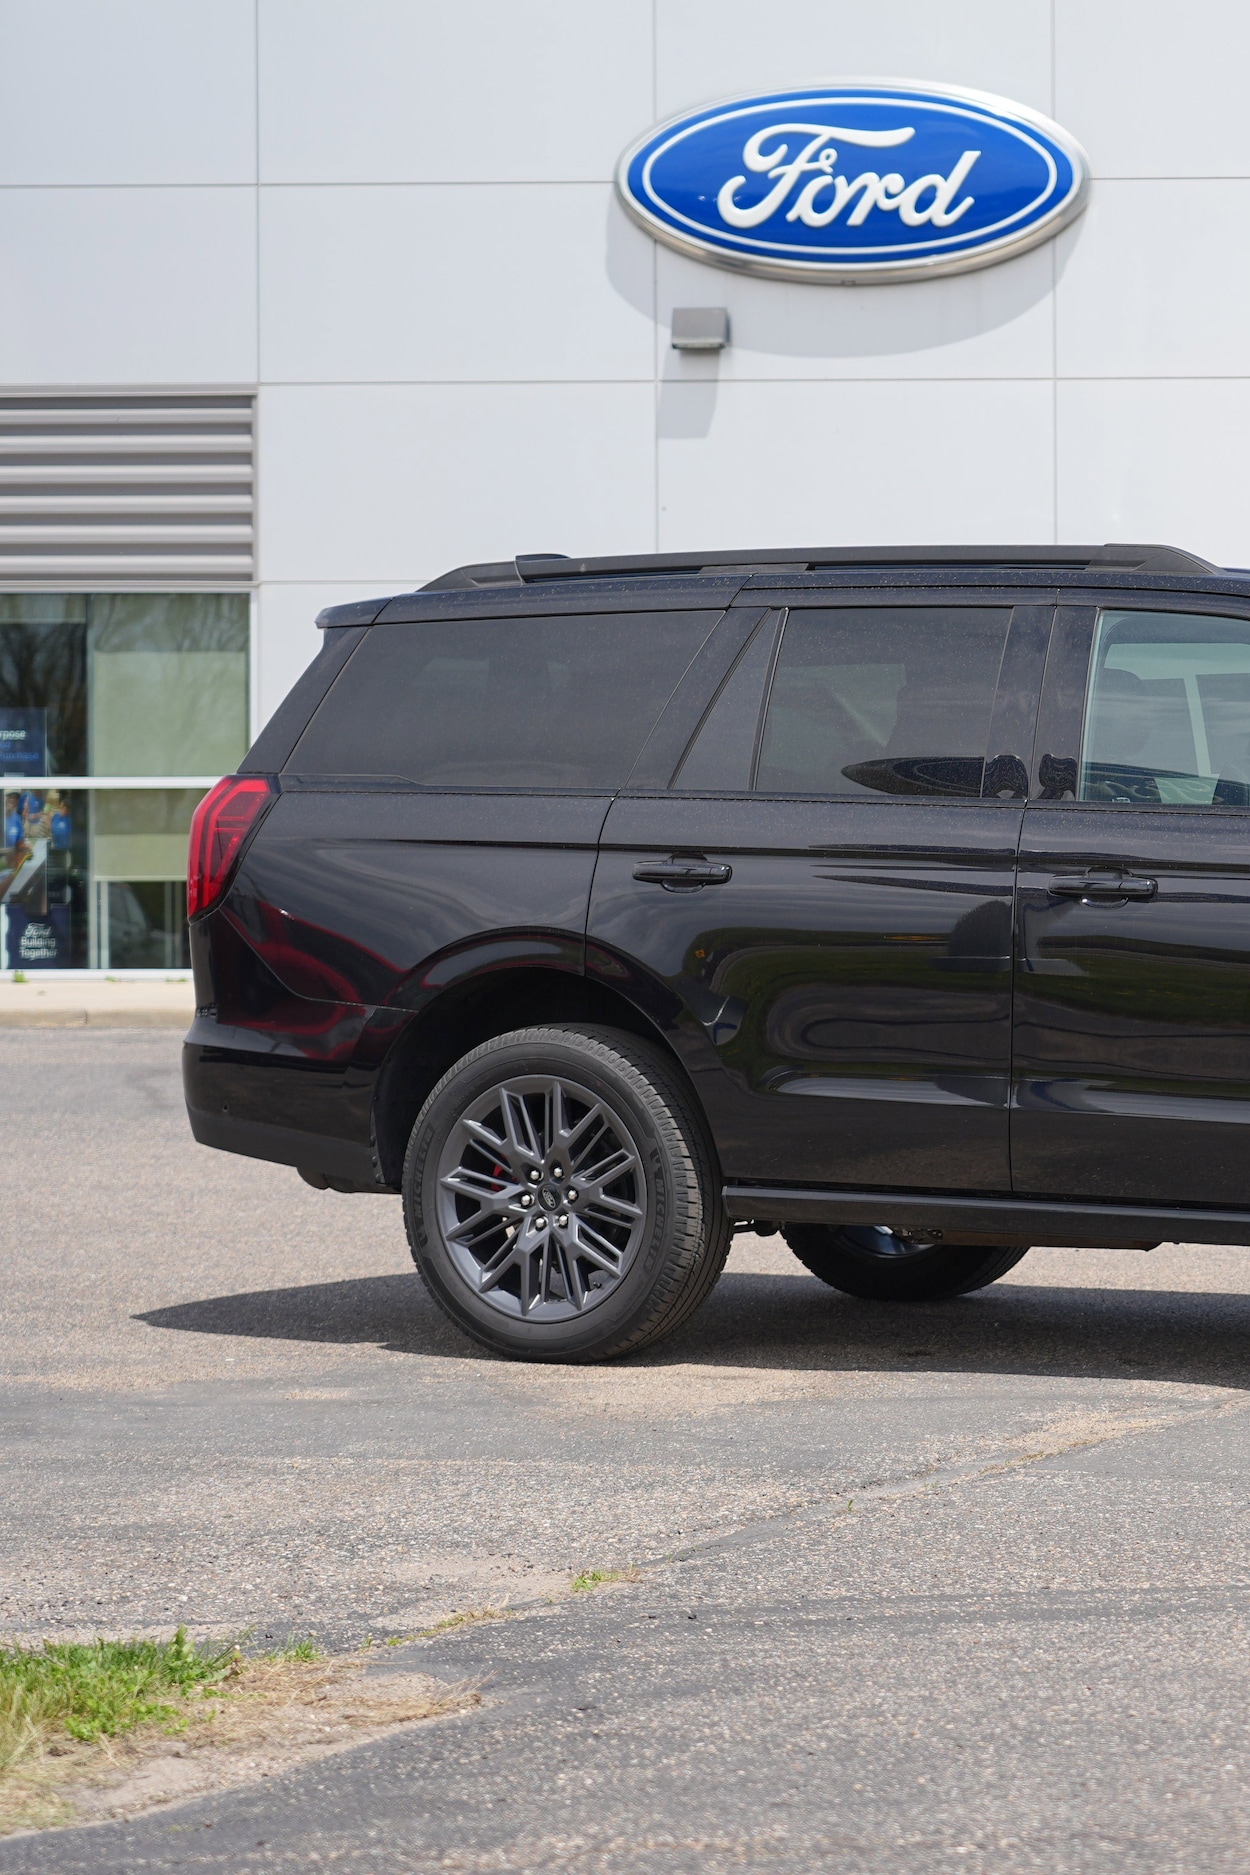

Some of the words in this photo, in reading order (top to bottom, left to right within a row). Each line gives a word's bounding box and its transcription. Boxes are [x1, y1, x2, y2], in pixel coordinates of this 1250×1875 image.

[717, 123, 981, 228] Ford
[25, 922, 51, 937] Ford
[21, 937, 56, 948] Building
[20, 947, 58, 961] Together
